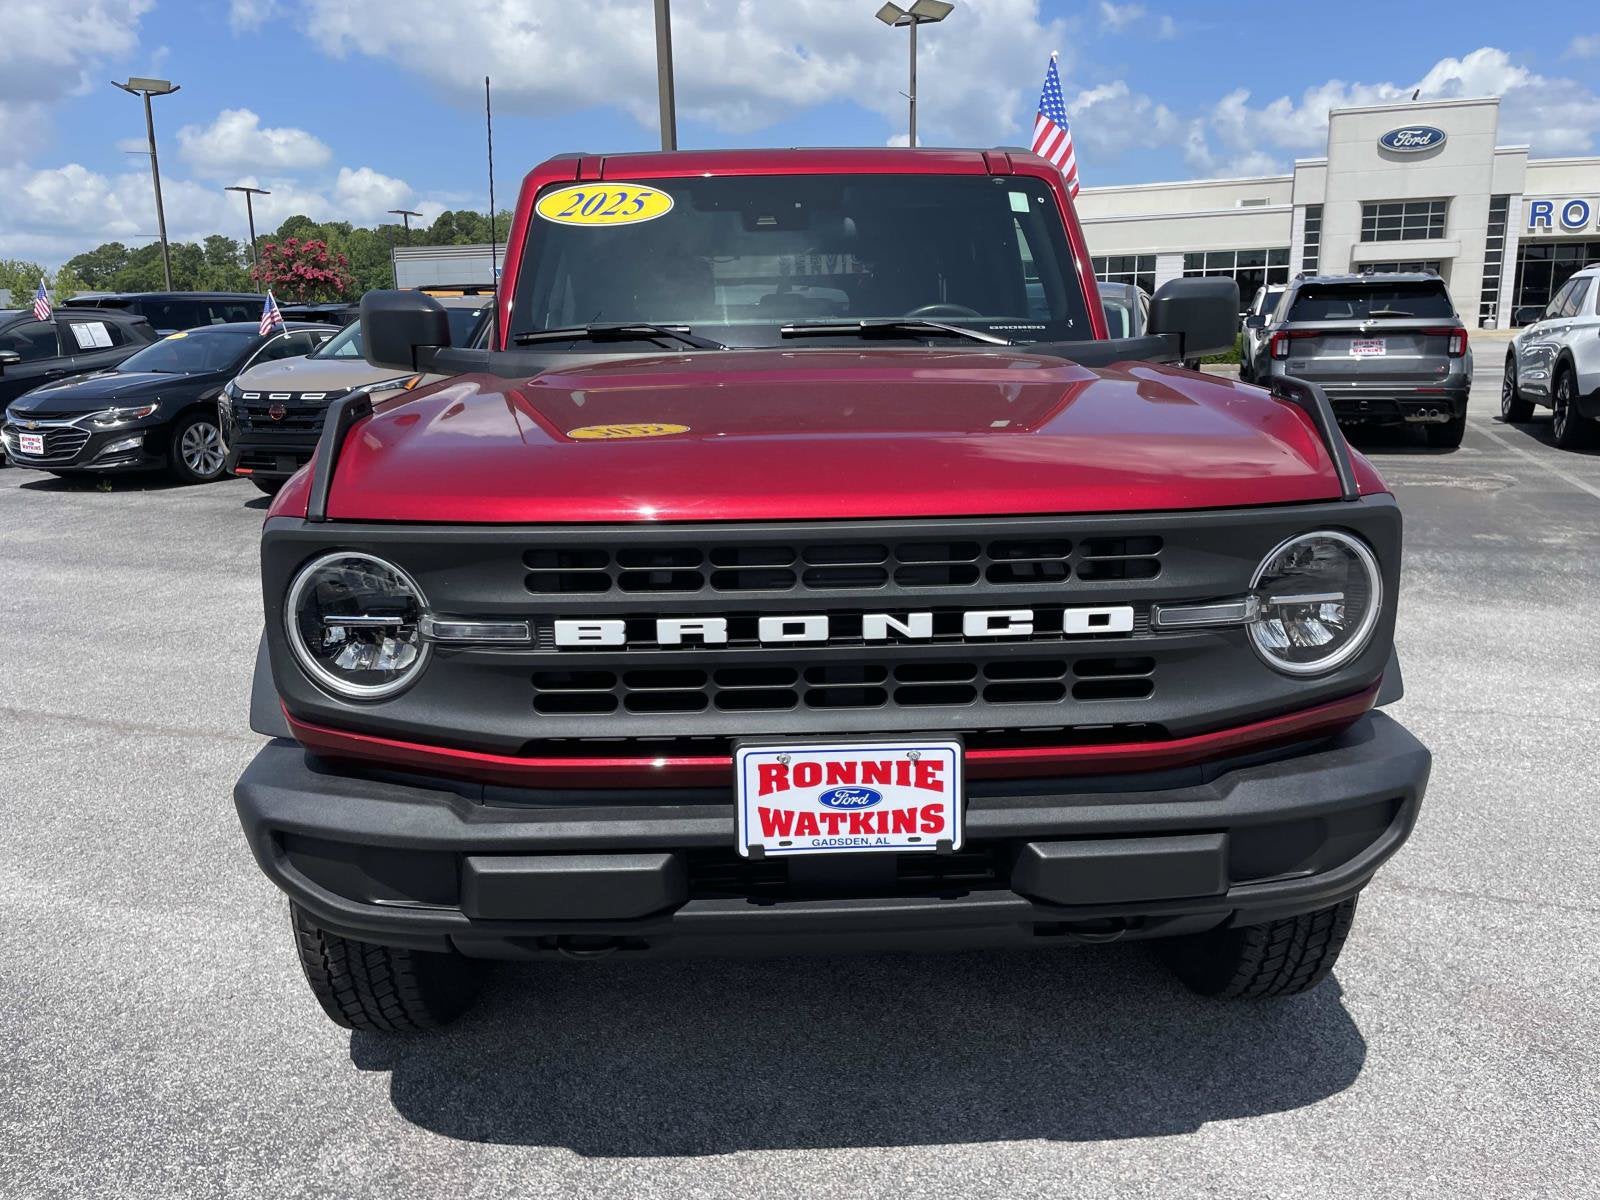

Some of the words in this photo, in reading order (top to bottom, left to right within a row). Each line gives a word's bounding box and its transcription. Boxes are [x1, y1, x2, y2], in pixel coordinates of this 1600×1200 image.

[1393, 130, 1432, 147] Ford
[556, 191, 653, 217] 2025
[1527, 199, 1600, 229] RO
[554, 606, 1135, 646] BRONCO
[758, 760, 944, 796] RONNIE
[830, 789, 870, 805] Ford
[758, 803, 945, 837] WATKINS
[812, 838, 872, 847] GADSDEN,
[875, 837, 890, 845] AL
